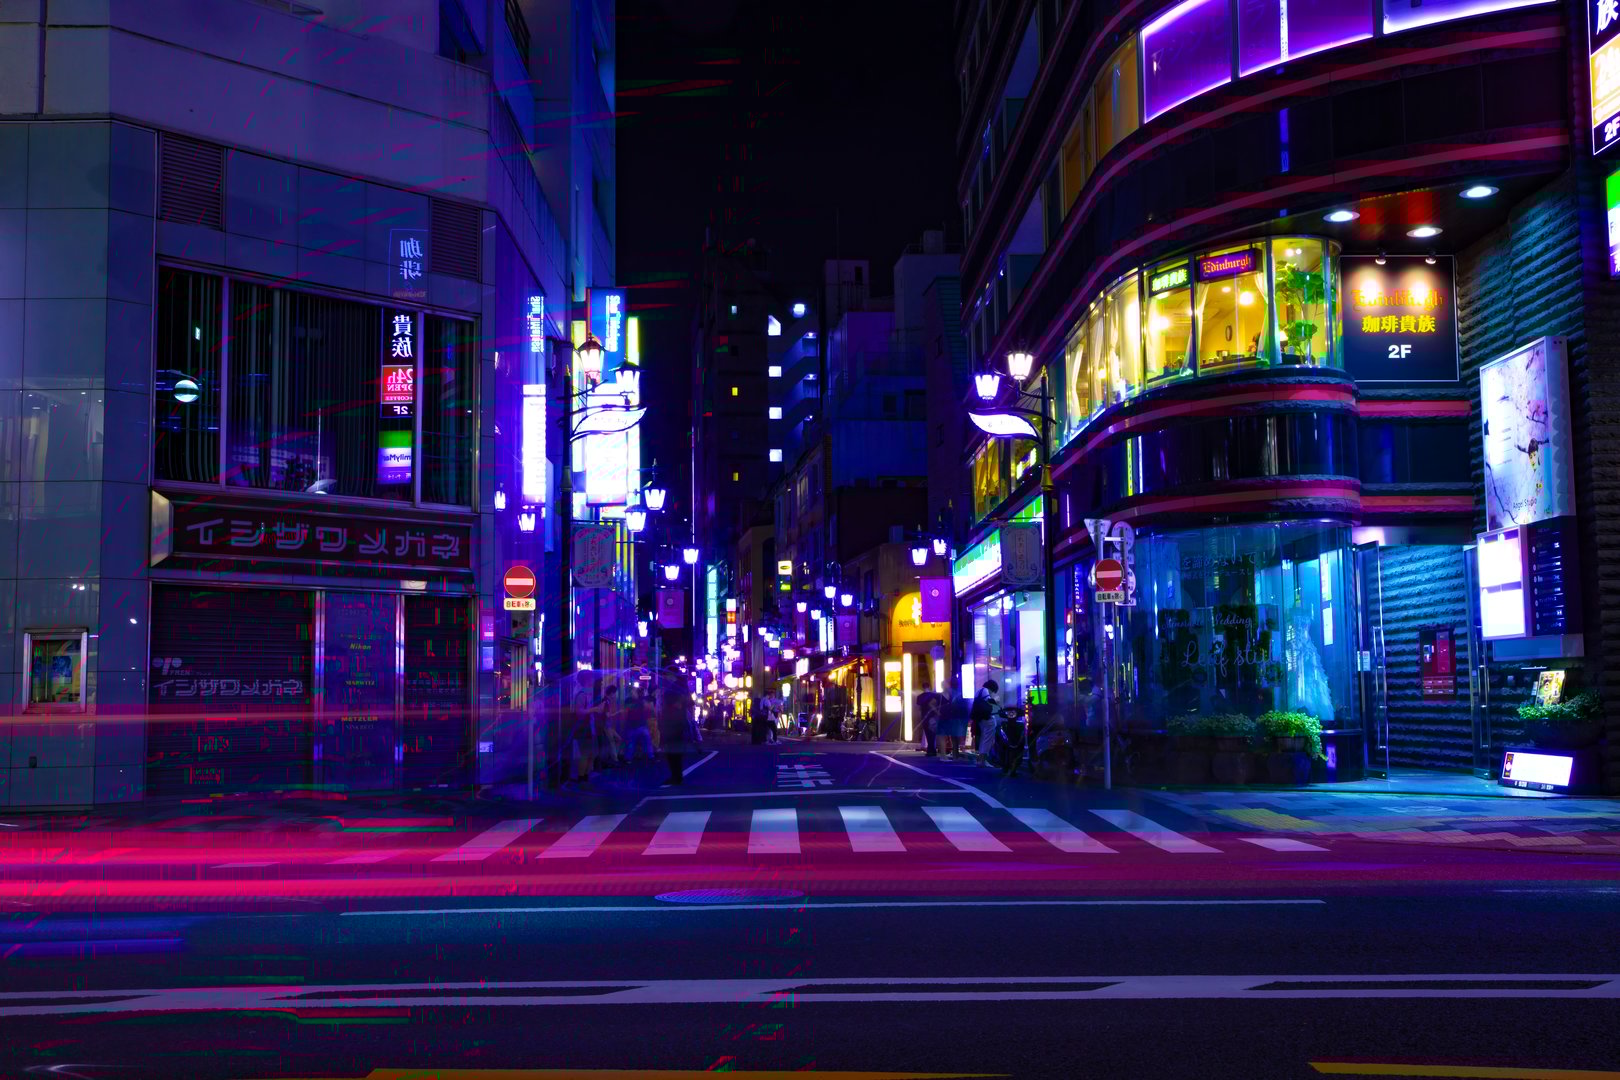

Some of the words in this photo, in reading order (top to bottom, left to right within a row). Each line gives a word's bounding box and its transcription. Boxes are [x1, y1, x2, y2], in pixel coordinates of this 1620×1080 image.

[1203, 254, 1251, 273] Edinburgh
[1351, 289, 1444, 312] Einbugh
[1362, 315, 1436, 333] 珈琲貴族
[1388, 345, 1412, 359] 2F
[187, 518, 460, 559] イシザワメガネ
[152, 679, 304, 696] イシザワメガネ
